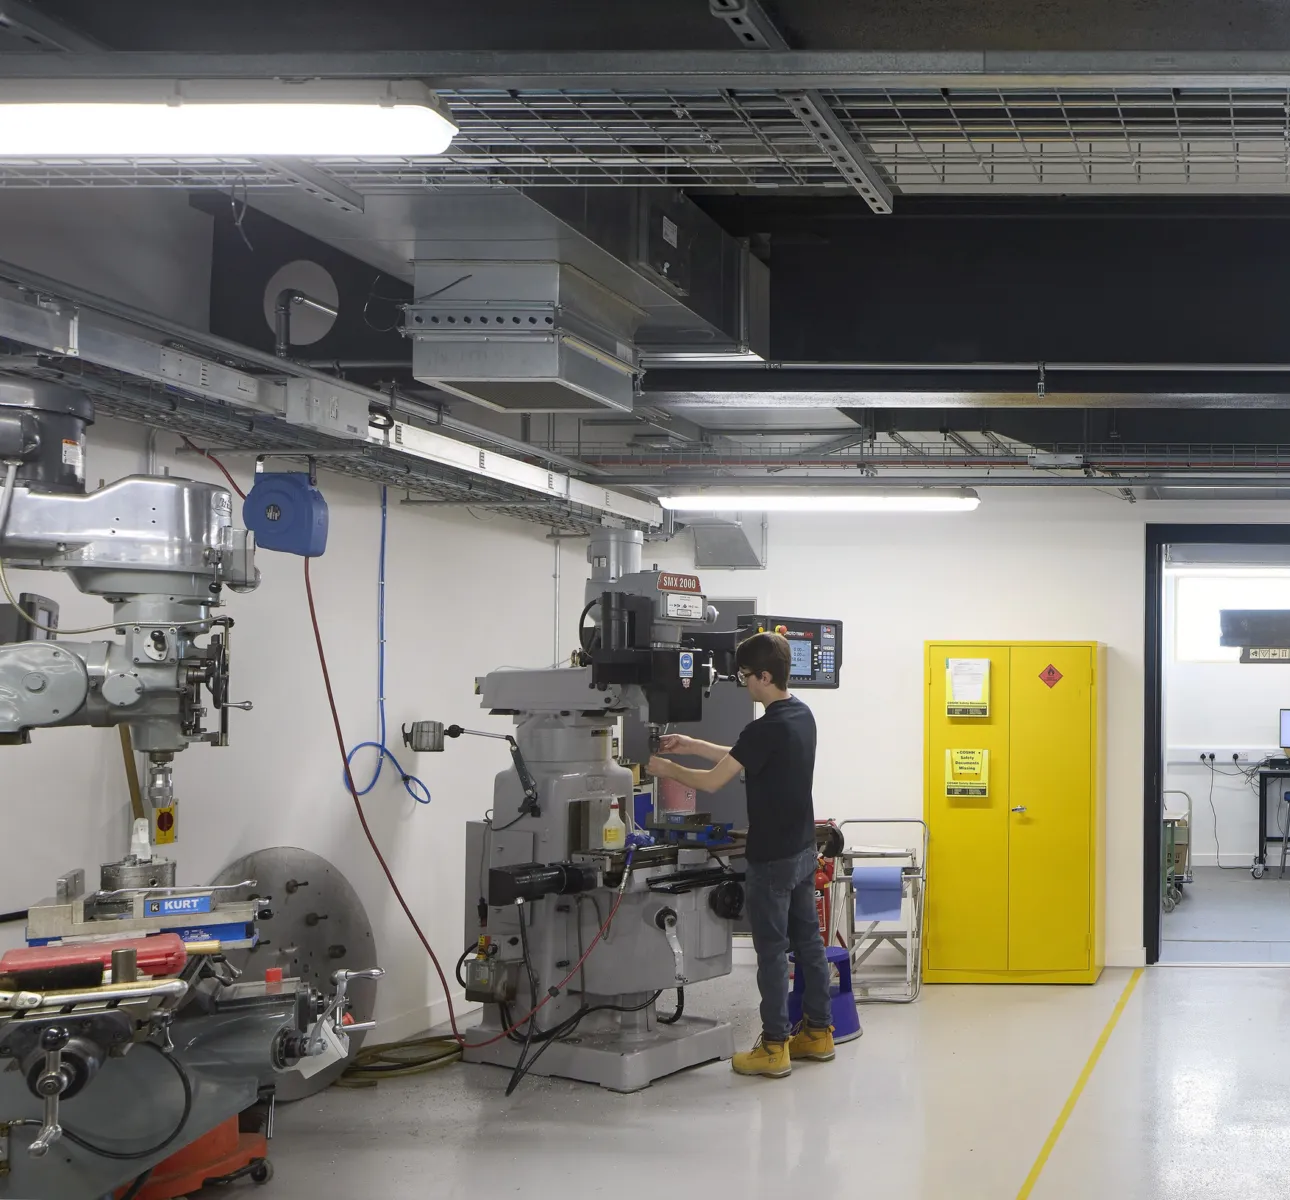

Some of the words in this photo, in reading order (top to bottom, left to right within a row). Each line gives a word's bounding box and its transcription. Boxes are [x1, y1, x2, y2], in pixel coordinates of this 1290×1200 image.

[663, 576, 678, 588] SMX
[680, 578, 696, 589] 2000
[164, 899, 199, 910] KURT
